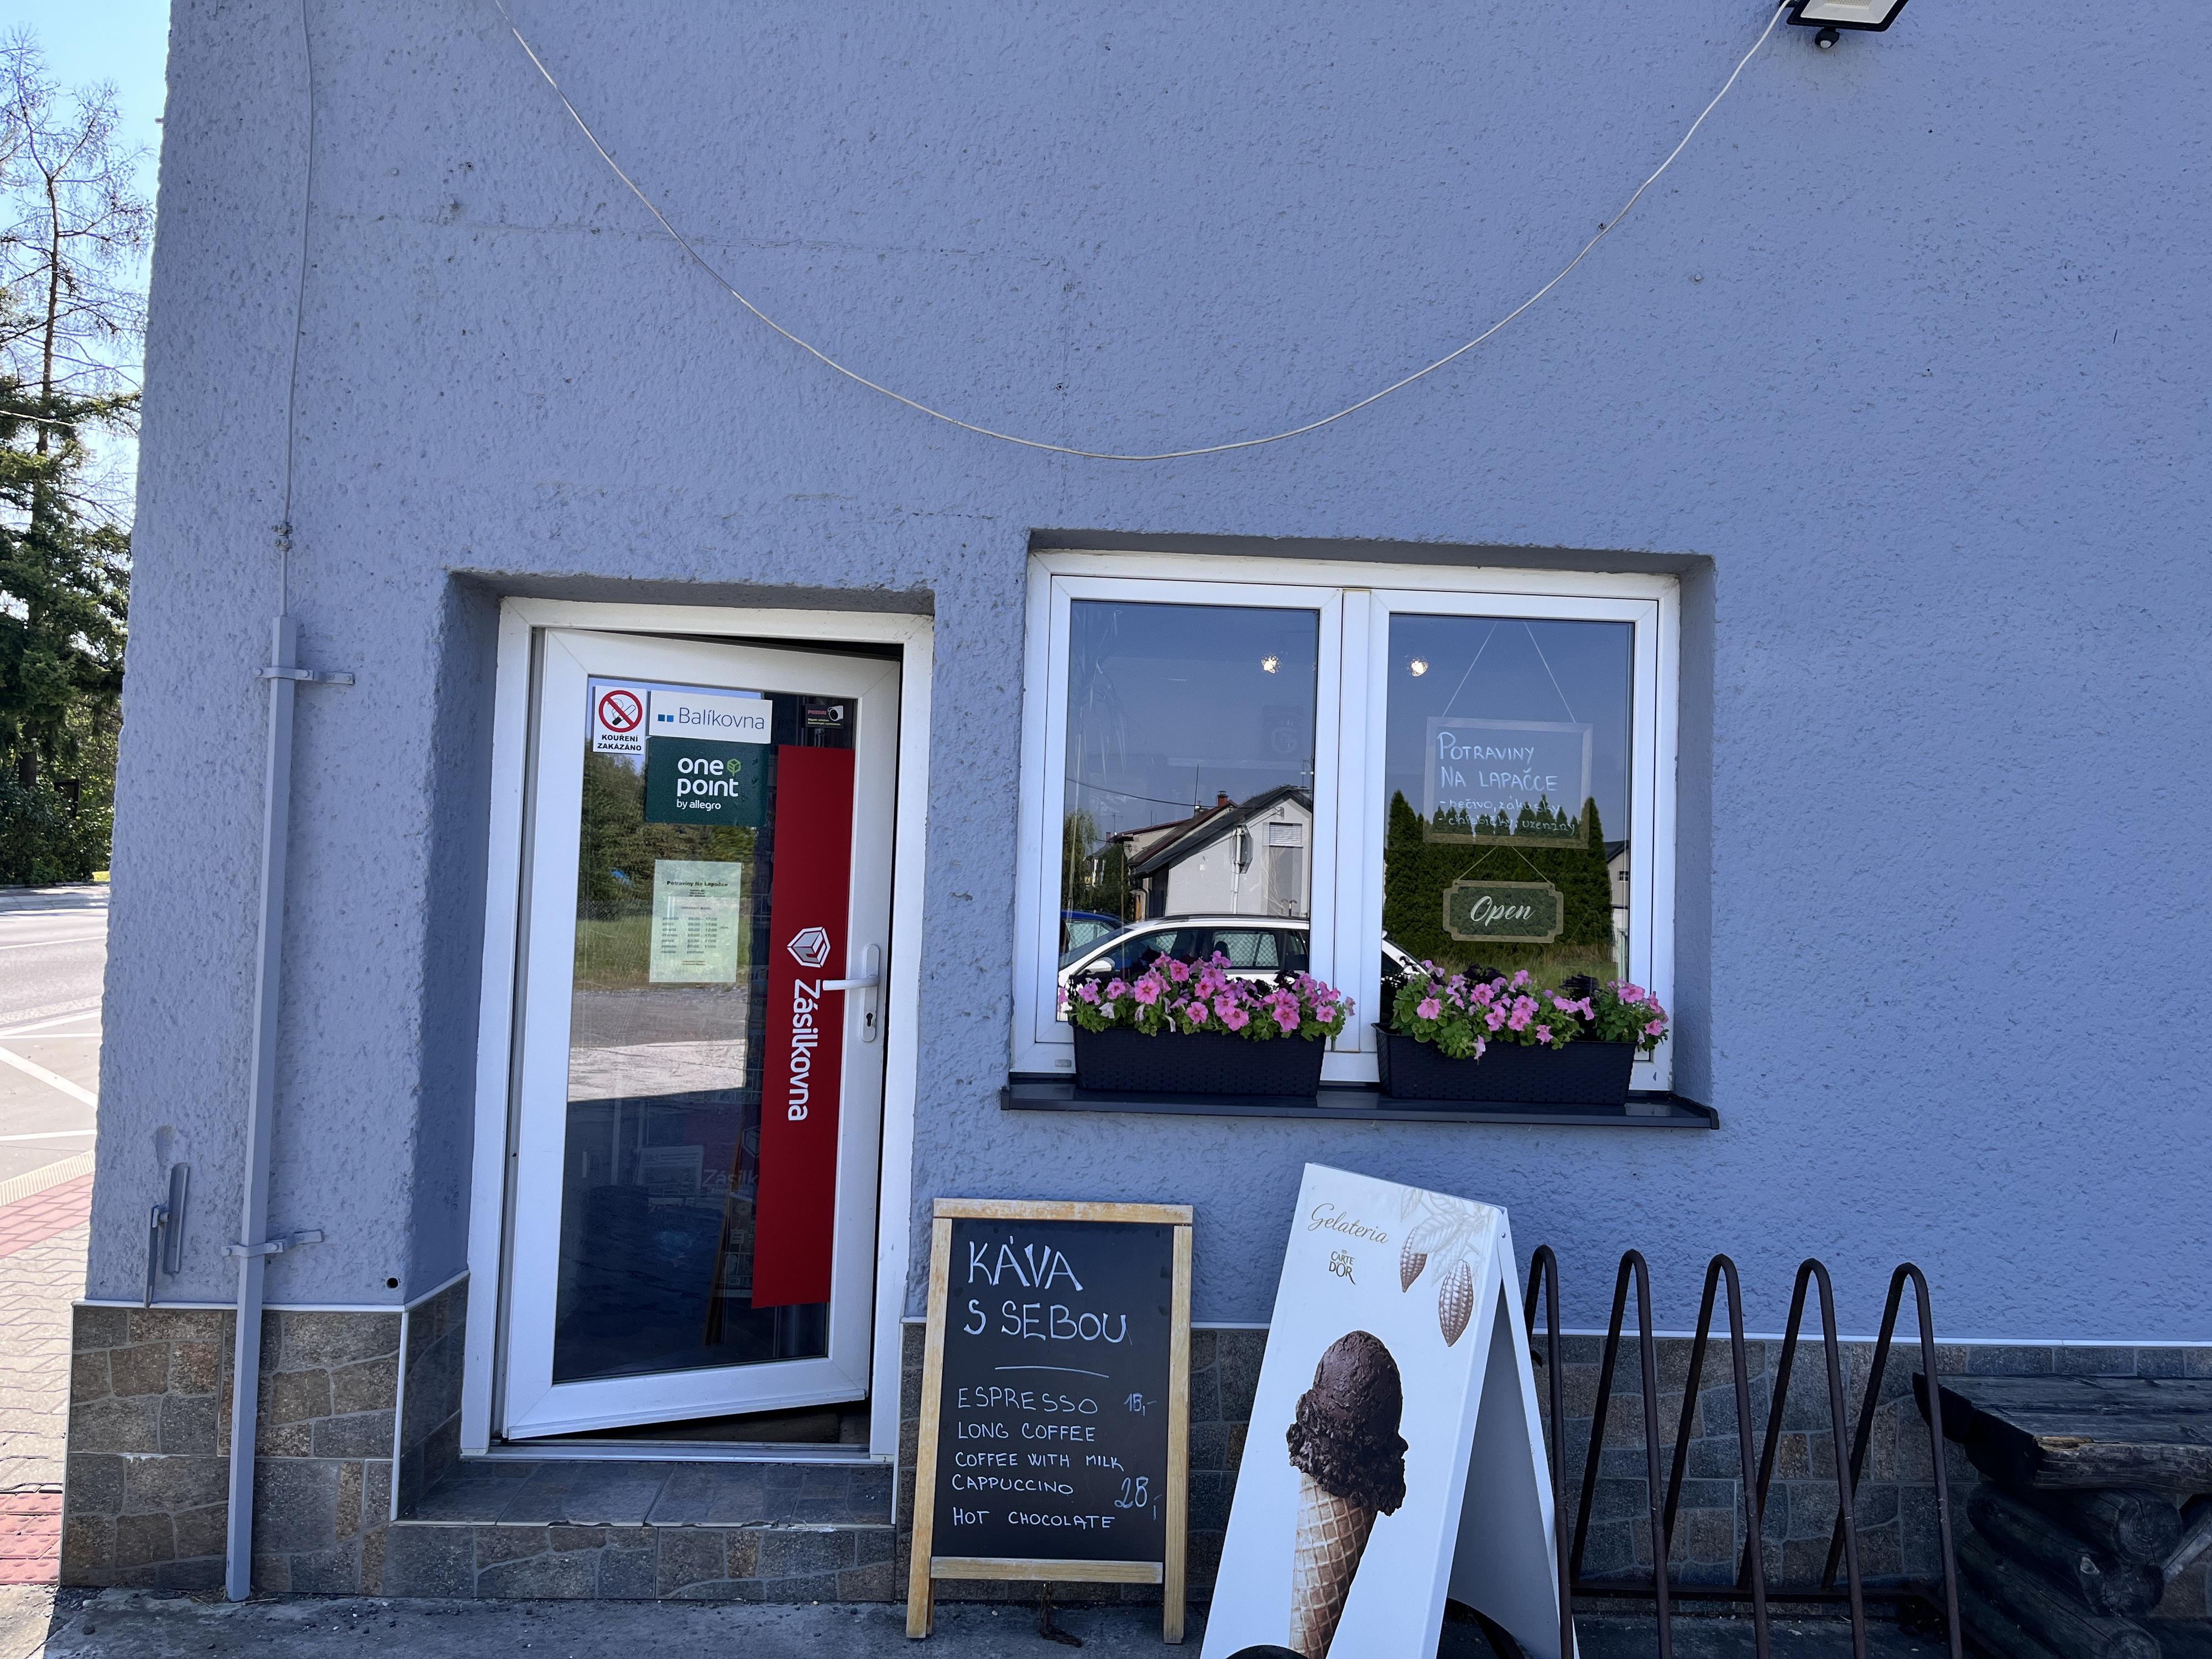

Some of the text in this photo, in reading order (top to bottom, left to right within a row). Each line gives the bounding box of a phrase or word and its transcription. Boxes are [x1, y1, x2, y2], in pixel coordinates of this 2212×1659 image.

[679, 707, 764, 729] Balíkovna
[677, 758, 724, 775] one
[677, 778, 739, 797] point
[1441, 766, 1558, 791] NA LAPAČCE
[676, 799, 721, 811] by allegro
[1470, 896, 1536, 926] Open
[788, 979, 821, 1121] Zásilkovna
[1308, 1203, 1389, 1244] Gelateria
[968, 1235, 1083, 1291] KÁVA
[1331, 1251, 1355, 1265] CARTE
[963, 1299, 1127, 1343] S SEBOU
[958, 1386, 1098, 1414] ESPRESSO
[958, 1422, 1096, 1442] LONG COFFEE
[955, 1452, 1124, 1472] COFFEE WITH MILK
[952, 1474, 1074, 1494] CAPPUCCINO
[953, 1506, 1115, 1530] HOT CHOCOLATE
